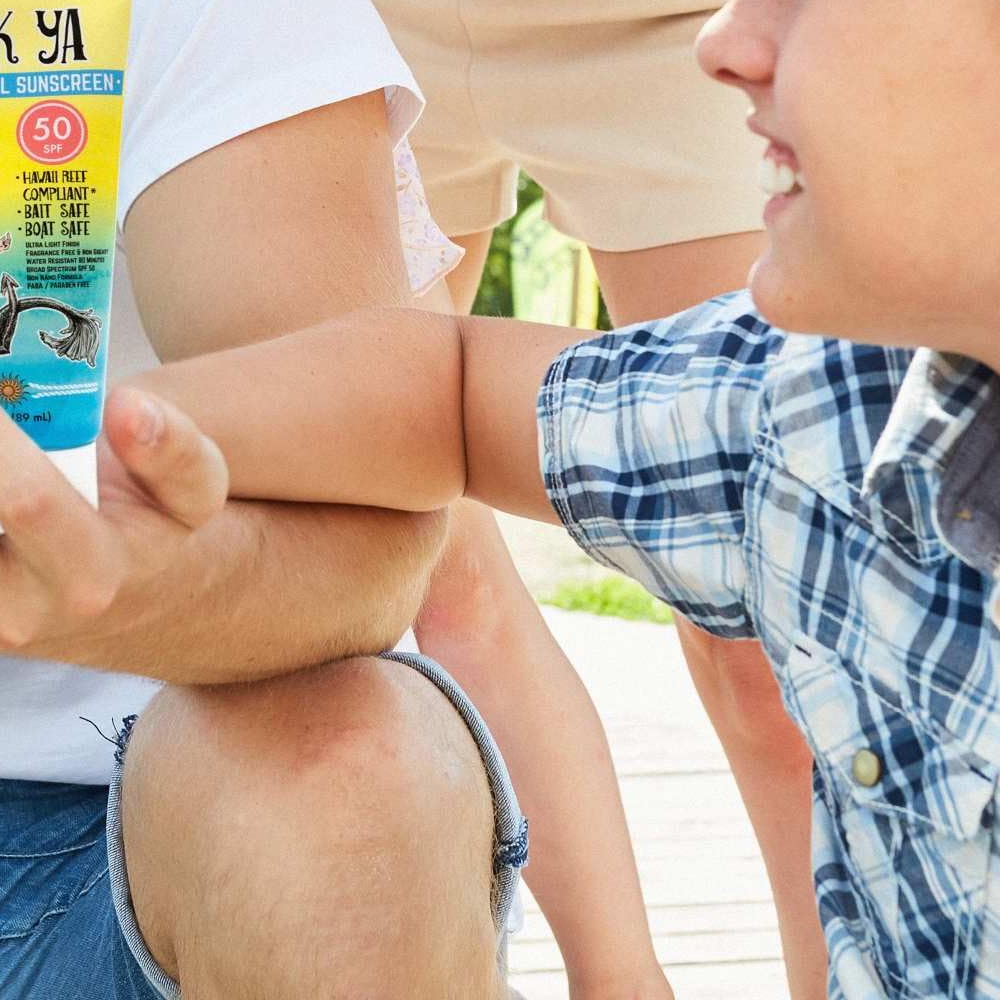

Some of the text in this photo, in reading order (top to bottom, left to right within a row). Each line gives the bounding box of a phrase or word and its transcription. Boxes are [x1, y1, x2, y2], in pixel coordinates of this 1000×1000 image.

[35, 8, 88, 64] YA
[16, 73, 114, 94] SUNSCREEN
[32, 116, 72, 141] 50
[43, 144, 63, 154] SPF
[23, 170, 88, 184] HAWAII REEF
[24, 203, 90, 219] BAIT SAFE
[25, 221, 90, 239] BOAT SAFE
[33, 411, 52, 423] mL)
